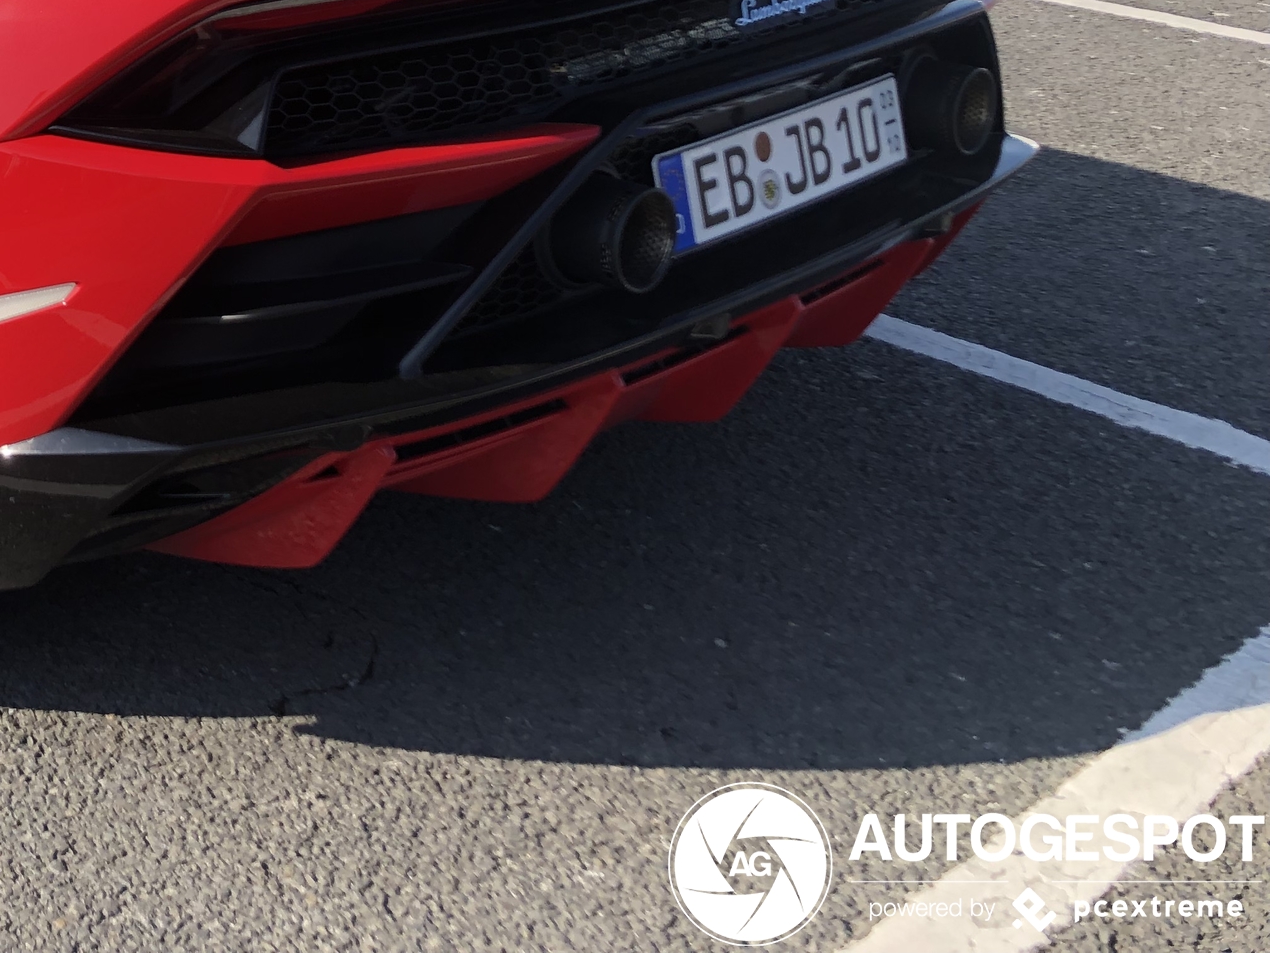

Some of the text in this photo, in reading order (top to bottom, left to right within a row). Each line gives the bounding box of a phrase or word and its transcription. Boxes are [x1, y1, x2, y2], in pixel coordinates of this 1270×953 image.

[693, 98, 880, 229] EB JB 10
